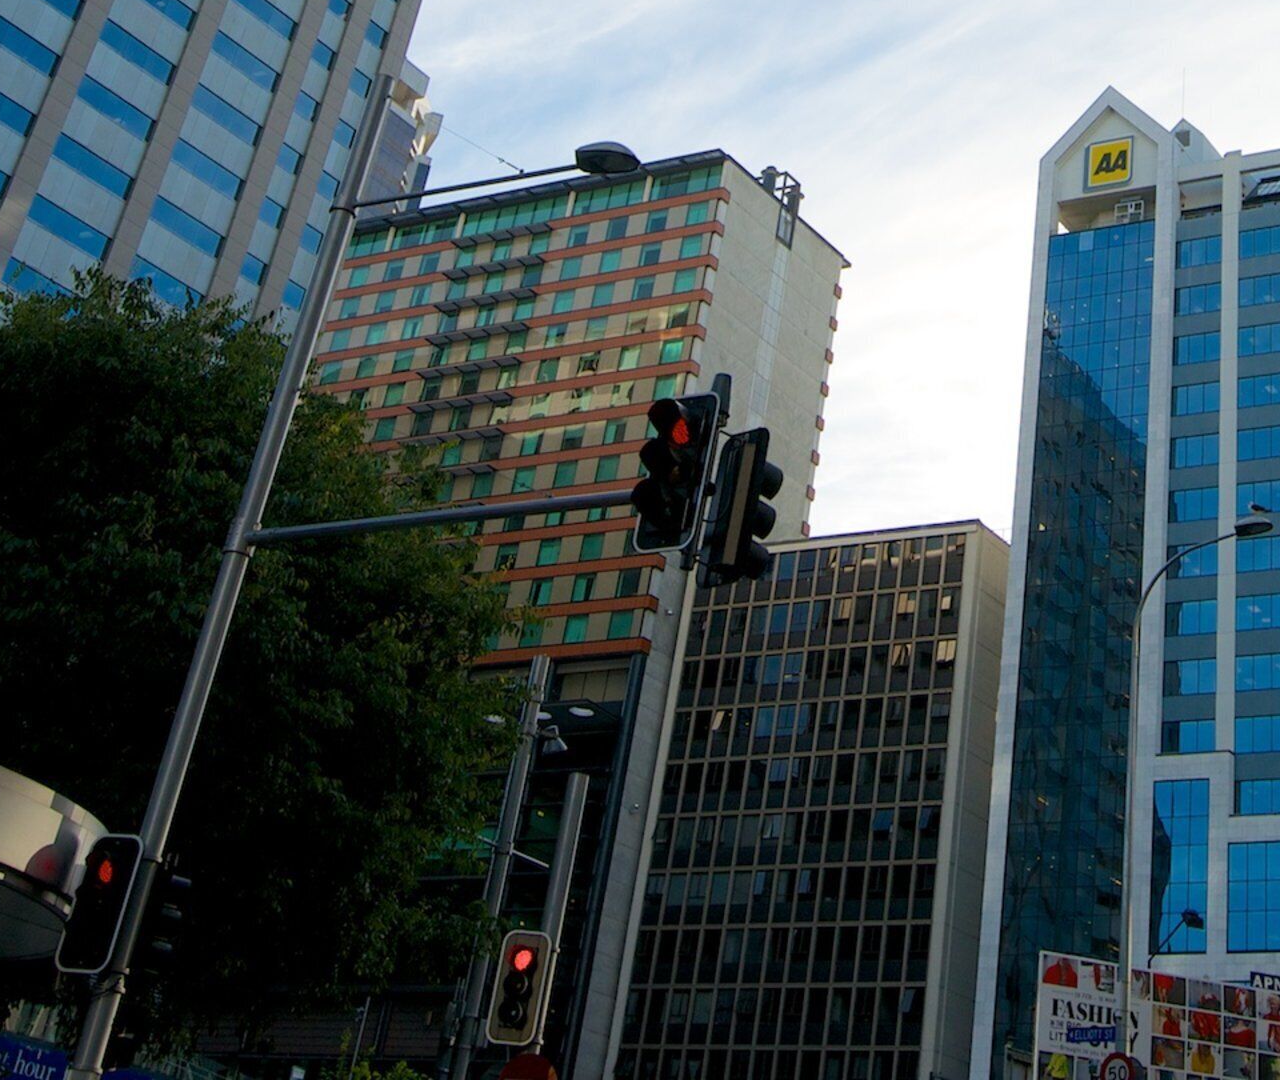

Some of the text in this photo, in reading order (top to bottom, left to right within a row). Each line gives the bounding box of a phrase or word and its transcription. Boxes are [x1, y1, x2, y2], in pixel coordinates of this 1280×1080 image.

[1093, 149, 1128, 176] AA
[1075, 1028, 1114, 1040] ELLIOTT ST
[12, 1048, 57, 1080] hour
[1108, 1065, 1127, 1080] 50
